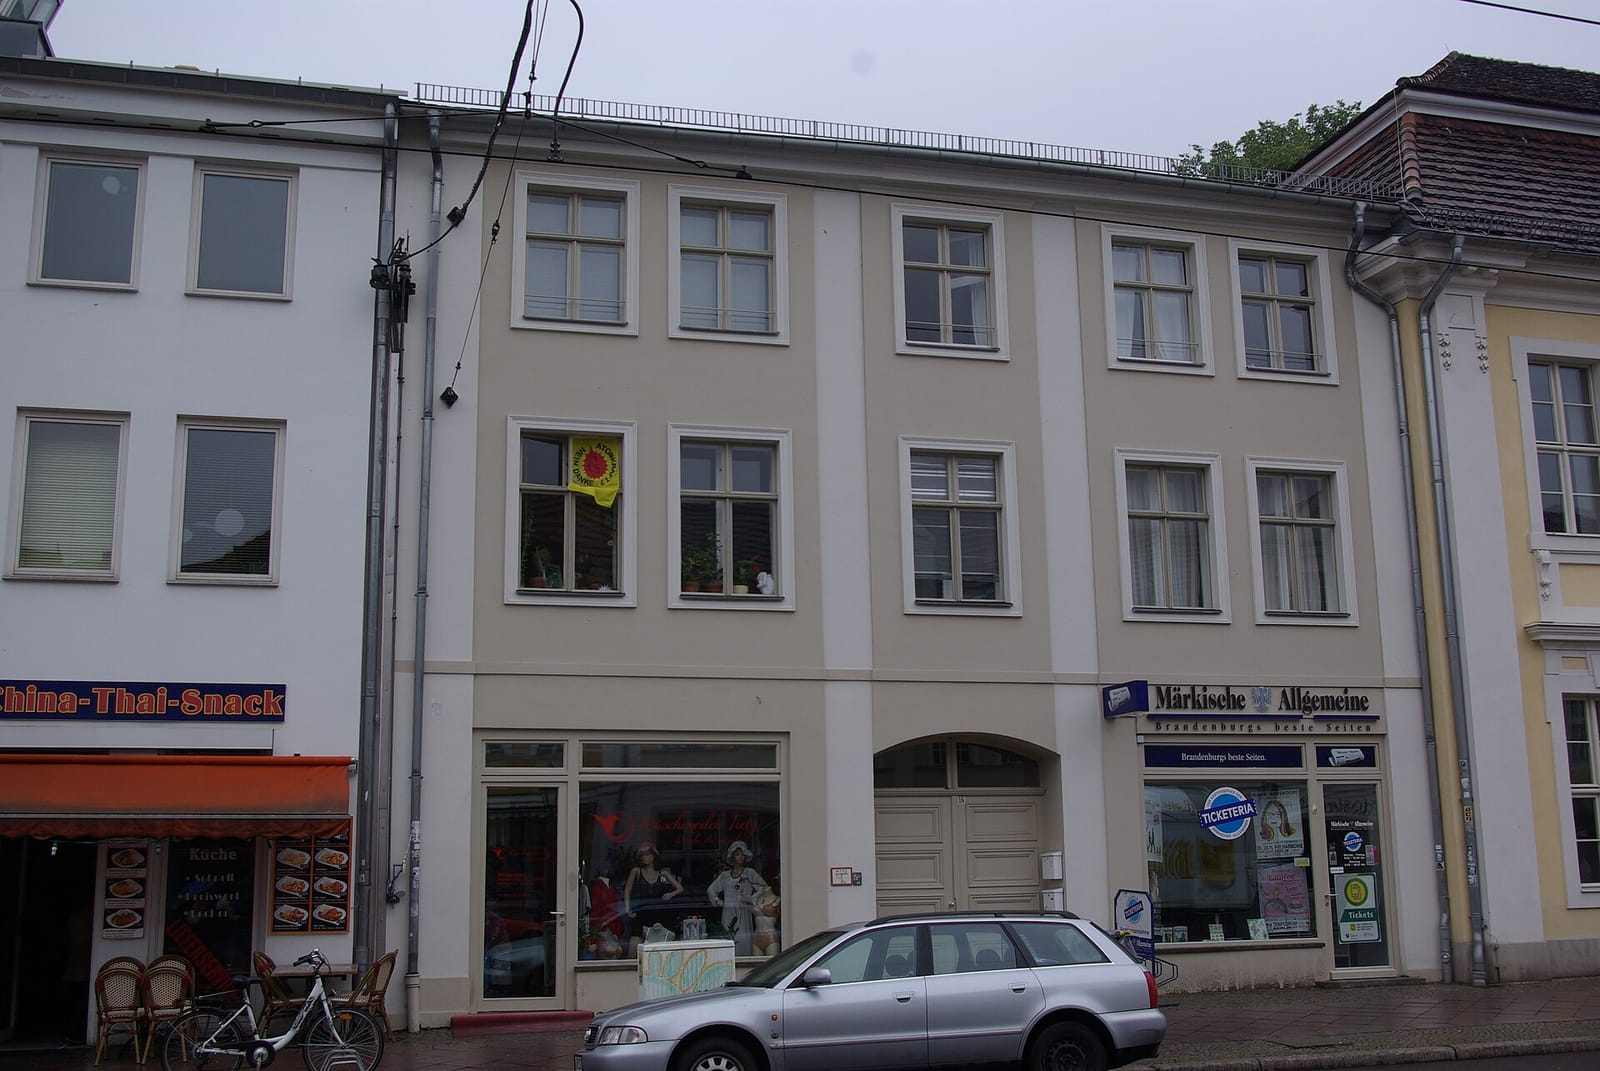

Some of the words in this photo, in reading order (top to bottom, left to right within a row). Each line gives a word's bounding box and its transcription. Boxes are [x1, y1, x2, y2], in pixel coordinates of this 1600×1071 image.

[0, 684, 285, 716] hina-Thai-Snack
[1155, 685, 1247, 711] Märkische
[1278, 687, 1370, 715] Allgemeine
[1155, 722, 1262, 733] Brandenburgs
[1274, 722, 1314, 732] beste
[1326, 722, 1372, 732] Seiten
[1181, 752, 1227, 763] Brandenburgs
[1227, 752, 1245, 761] beste
[1245, 752, 1267, 761] Seiten.
[1201, 802, 1255, 825] TICKETERIA
[189, 847, 240, 861] Küche
[1348, 911, 1374, 919] Tickets
